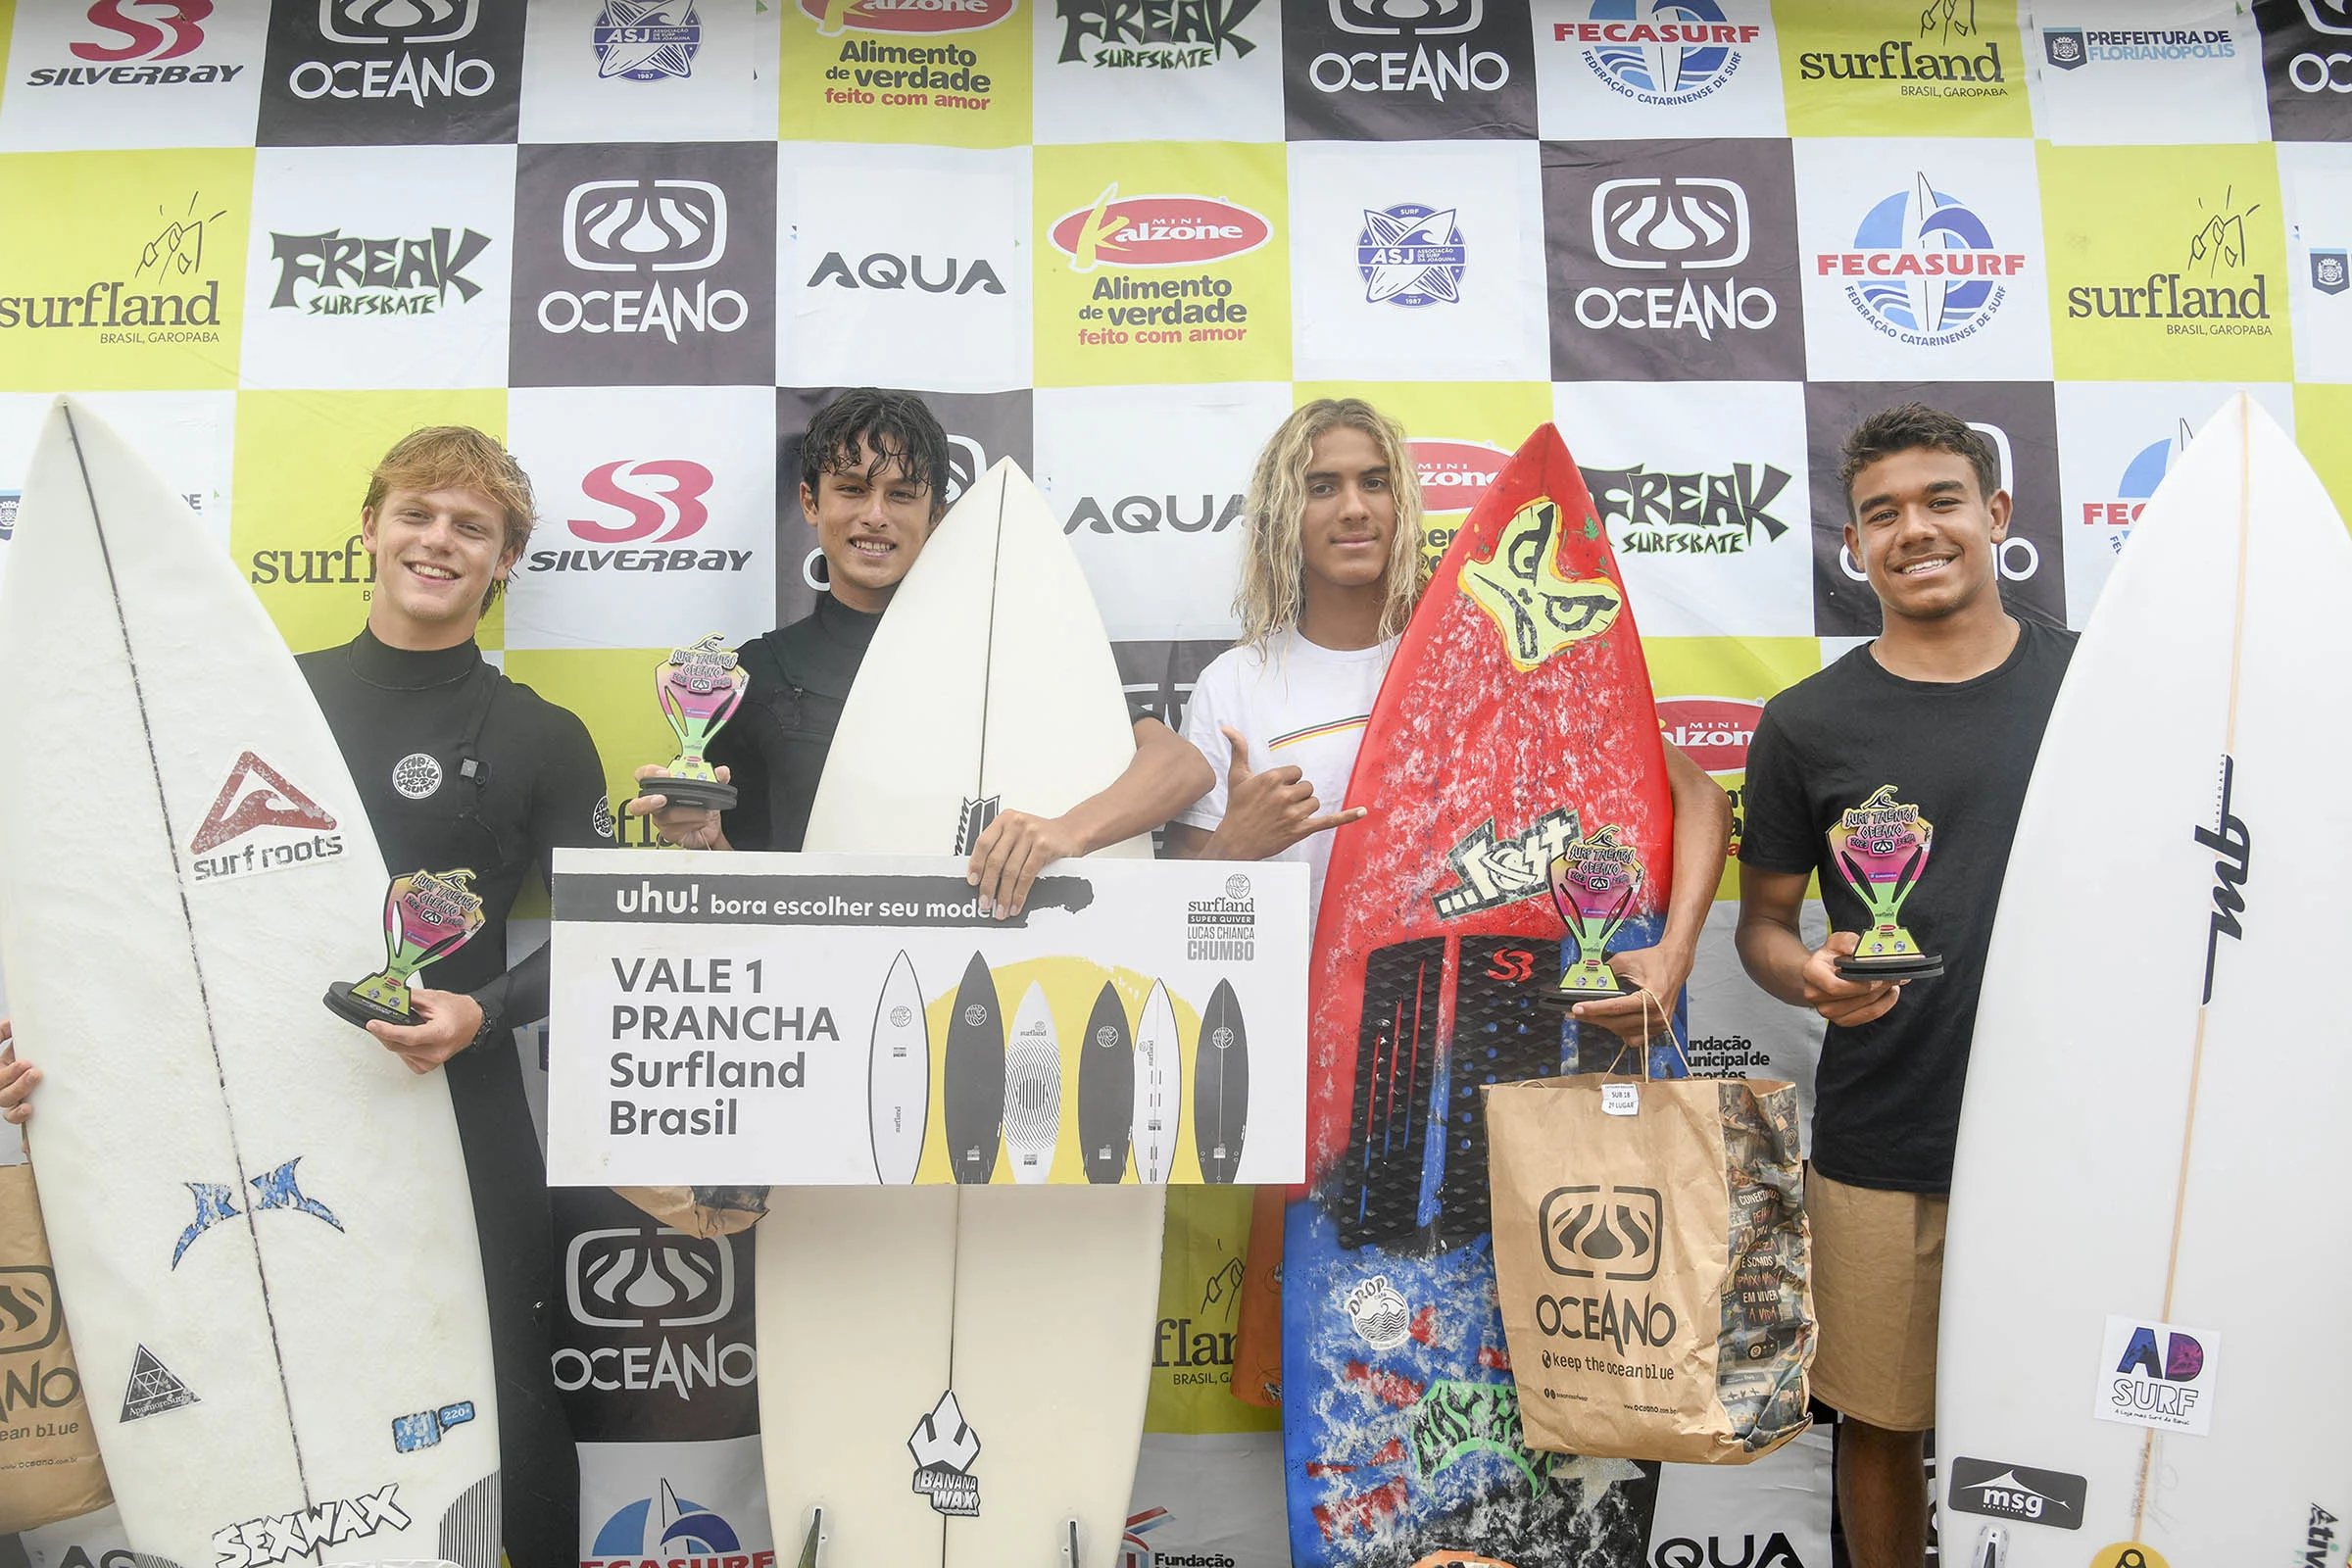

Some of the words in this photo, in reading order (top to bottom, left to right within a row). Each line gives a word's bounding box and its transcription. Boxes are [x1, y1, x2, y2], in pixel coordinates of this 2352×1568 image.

[606, 28, 650, 43] ASJ
[1055, 0, 1257, 63] FREAK
[1553, 24, 1759, 43] FECASURF
[2086, 30, 2204, 45] PREFEITURA
[2205, 30, 2231, 42] DE
[840, 40, 977, 66] Alimento
[1094, 48, 1215, 70] SURFSKATE
[1799, 40, 2005, 82] surfland
[2088, 43, 2235, 61] FLORIANÓPOLIS
[26, 65, 244, 86] SILVERBAY
[289, 50, 495, 108] OCEANO
[825, 67, 850, 79] de
[855, 66, 991, 92] verdade
[1309, 41, 1509, 102] OCEANO
[1582, 50, 1634, 98] FEDERAÇÃO
[1638, 85, 1713, 106] CATARINENSE
[1713, 75, 1728, 89] DE
[1727, 51, 1742, 76] SURF
[824, 88, 875, 105] feito
[881, 93, 928, 106] com
[934, 93, 991, 110] amor
[1901, 85, 1941, 98] BRASIL,
[1943, 86, 2008, 98] GAROPABA
[269, 227, 492, 309] FREAK
[1370, 248, 1414, 265] ASJ
[1817, 254, 2026, 275] FECASURF
[807, 252, 1006, 295] AQUA
[1092, 275, 1232, 300] Alimento
[2068, 273, 2271, 319] surfland
[0, 280, 220, 328] surfland
[308, 294, 438, 316] SURFSKATE
[537, 278, 749, 345] OCEANO
[1078, 306, 1103, 319] de
[1107, 298, 1247, 325] verdade
[1574, 275, 1778, 342] OCEANO
[1845, 285, 1896, 338] FEDERAÇÃO
[1900, 324, 1977, 346] CATARINENSE
[1976, 314, 1991, 327] DE
[1990, 285, 2007, 314] SURF
[100, 333, 145, 344] BRASIL,
[148, 331, 220, 343] GAROPABA
[1078, 327, 1129, 345] feito
[1135, 330, 1182, 343] com
[1189, 328, 1248, 342] amor
[2167, 324, 2208, 336] BRASIL,
[2210, 324, 2273, 336] GAROPABA
[1577, 463, 1792, 546] FREAK
[1622, 532, 1744, 554] SURFSKATE
[527, 550, 753, 572] SILVERBAY
[193, 844, 254, 880] surf
[261, 835, 343, 868] roots
[616, 881, 699, 914] uhu!
[710, 895, 766, 915] bora
[773, 896, 876, 917] escolher
[879, 901, 919, 917] seu
[1188, 897, 1254, 912] surfland
[1188, 926, 1215, 939] LUCAS
[1217, 926, 1254, 940] CHIANCA
[1187, 941, 1254, 960] CHUMBO
[612, 957, 732, 993] VALE
[746, 958, 762, 994] 1
[612, 1004, 840, 1041] PRANCHA
[610, 1050, 806, 1089] Surfland
[1749, 1053, 1770, 1066] de
[610, 1098, 738, 1135] Brasil
[1348, 1278, 1385, 1315] DROP
[1536, 1288, 1677, 1357] OCEANO
[551, 1333, 757, 1400] OCEANO
[1553, 1352, 1582, 1372] keep
[1586, 1356, 1605, 1372] the
[1607, 1362, 1642, 1379] ocean
[1645, 1364, 1674, 1380] blue
[2116, 1327, 2204, 1383] AD
[1173, 1373, 1217, 1386] BRASIL,
[2112, 1379, 2199, 1416] SURF
[36, 1422, 79, 1437] blue
[921, 1470, 977, 1491] BANANA
[932, 1491, 977, 1509] WAX
[1984, 1489, 2043, 1518] msg
[213, 1483, 412, 1568] SEXWAX
[1154, 1553, 1235, 1568] Fundação
[1647, 1532, 1804, 1568] QUA
